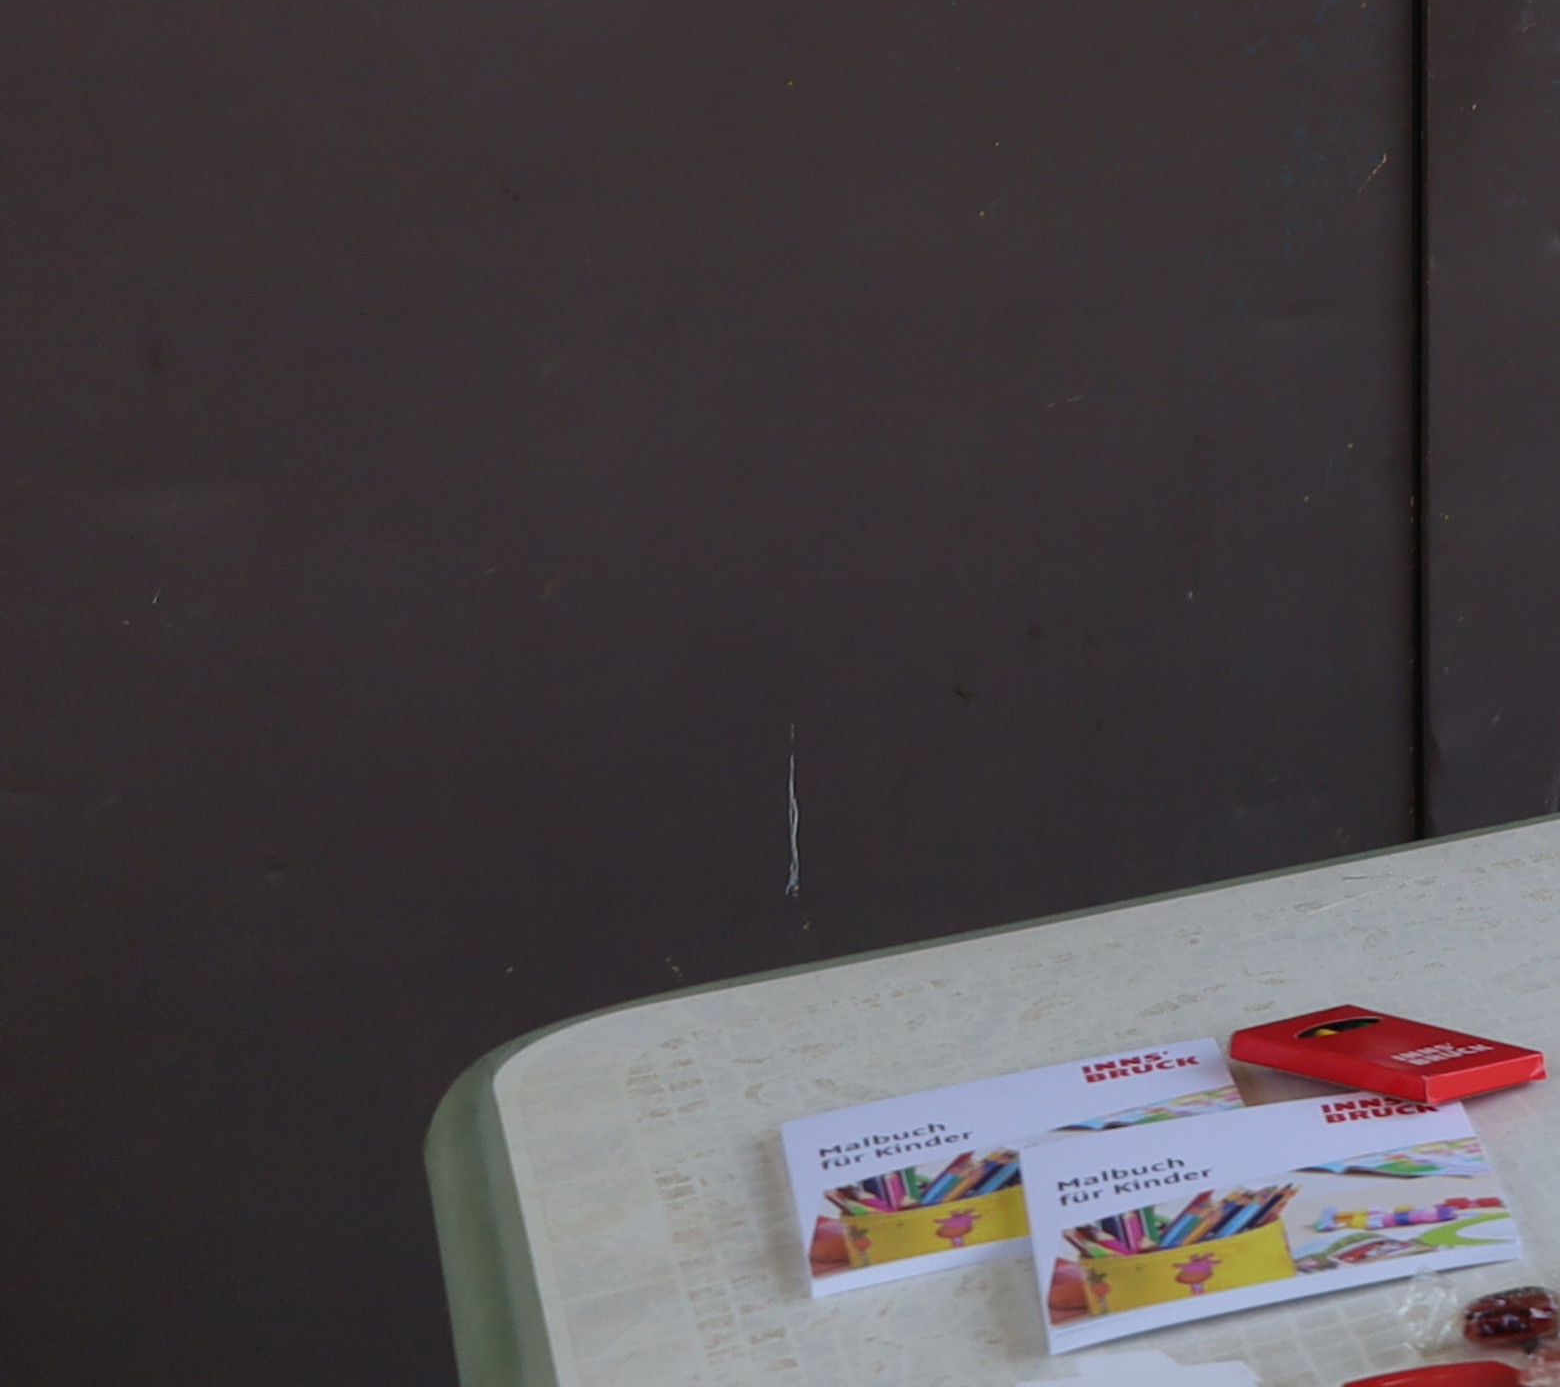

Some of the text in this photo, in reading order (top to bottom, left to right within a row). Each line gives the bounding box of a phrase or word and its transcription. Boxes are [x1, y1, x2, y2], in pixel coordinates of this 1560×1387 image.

[1080, 1050, 1170, 1075] INNS'
[1391, 1042, 1455, 1061] INNS'
[1407, 1044, 1494, 1066] BRUCK
[1085, 1055, 1200, 1084] BRUCK
[1321, 1096, 1404, 1114] INNS
[1324, 1103, 1440, 1124] BRUCK
[818, 1122, 946, 1158] Malbuch
[820, 1131, 975, 1172] für Kinder
[1056, 1156, 1187, 1192] Malbuch
[1058, 1167, 1213, 1206] für Kinder
